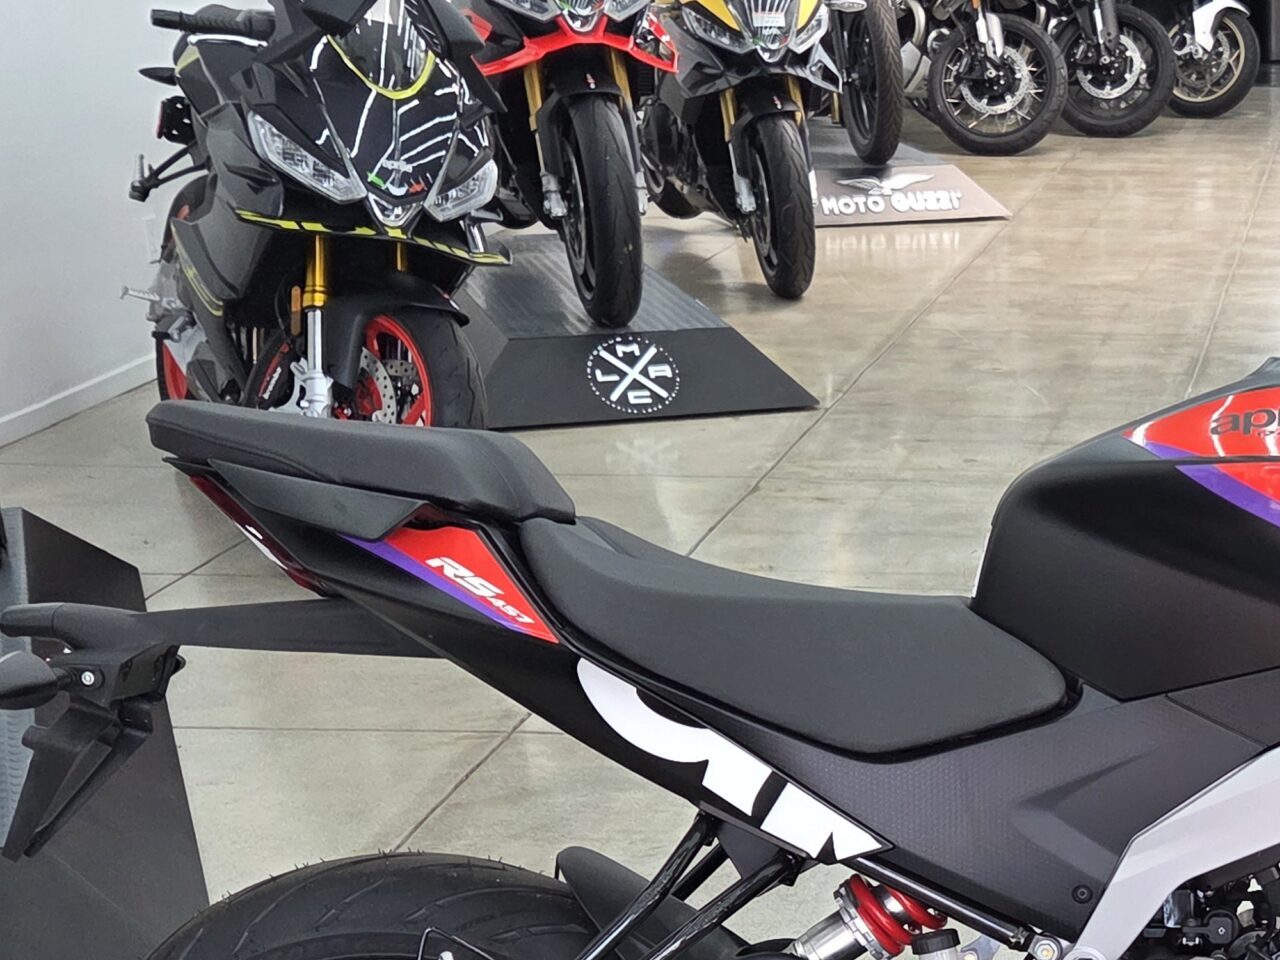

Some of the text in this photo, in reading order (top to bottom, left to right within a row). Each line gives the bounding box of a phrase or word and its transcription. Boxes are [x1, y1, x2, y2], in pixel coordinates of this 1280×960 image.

[822, 194, 886, 216] MOTO
[425, 556, 536, 624] RS 457
